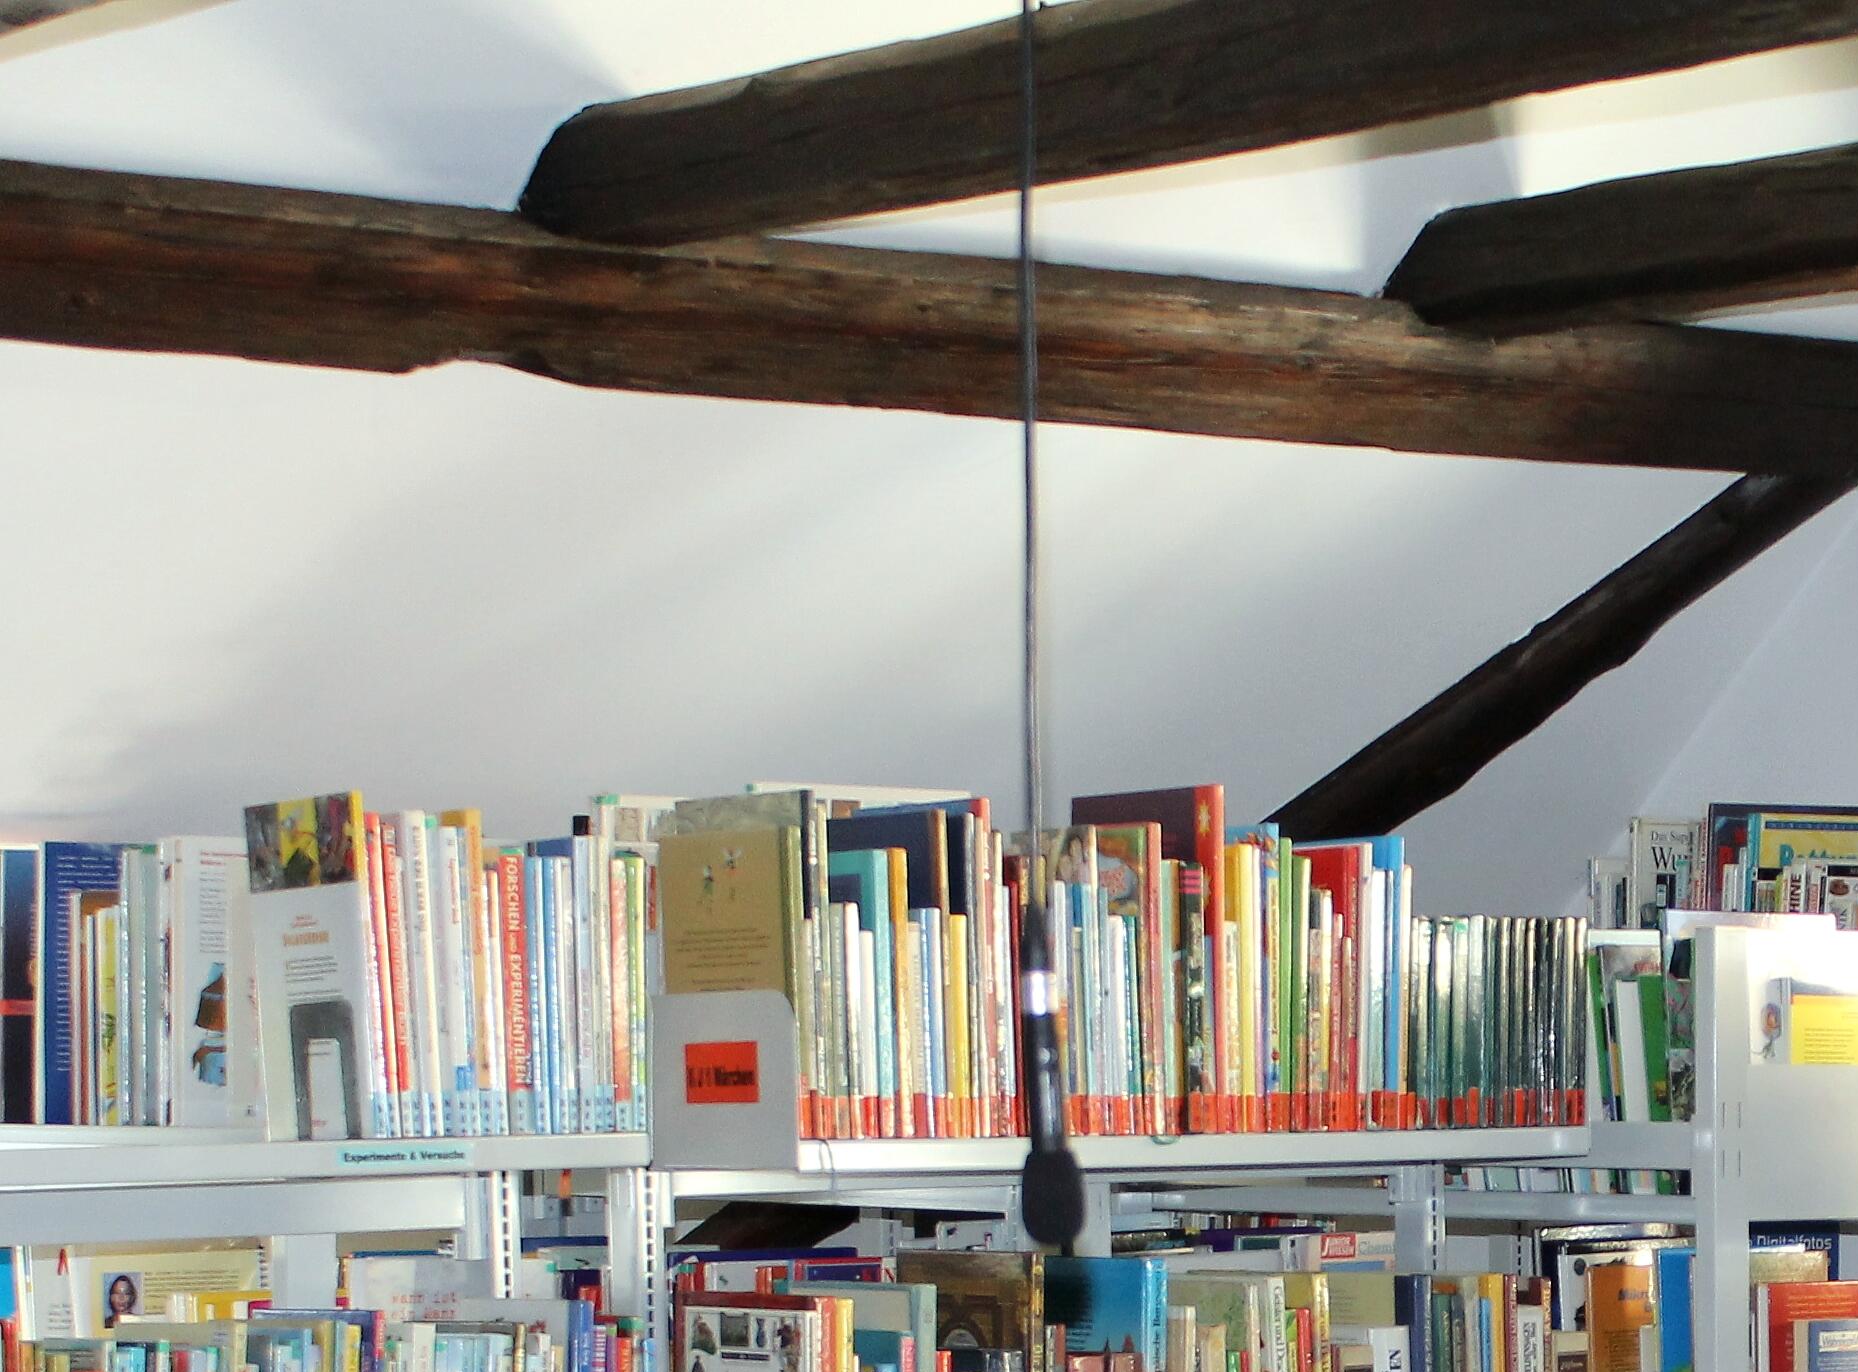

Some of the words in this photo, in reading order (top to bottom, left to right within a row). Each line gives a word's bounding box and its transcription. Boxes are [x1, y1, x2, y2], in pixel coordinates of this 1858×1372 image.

[505, 857, 521, 931] FORSCHEN
[1789, 874, 1801, 913] HINE
[509, 954, 529, 1085] EXPERIMENTIEREN
[344, 1151, 406, 1163] Experimente
[421, 1151, 465, 1161] Versuche
[1757, 1235, 1832, 1250] Digitalfotos
[1275, 1325, 1285, 1344] und
